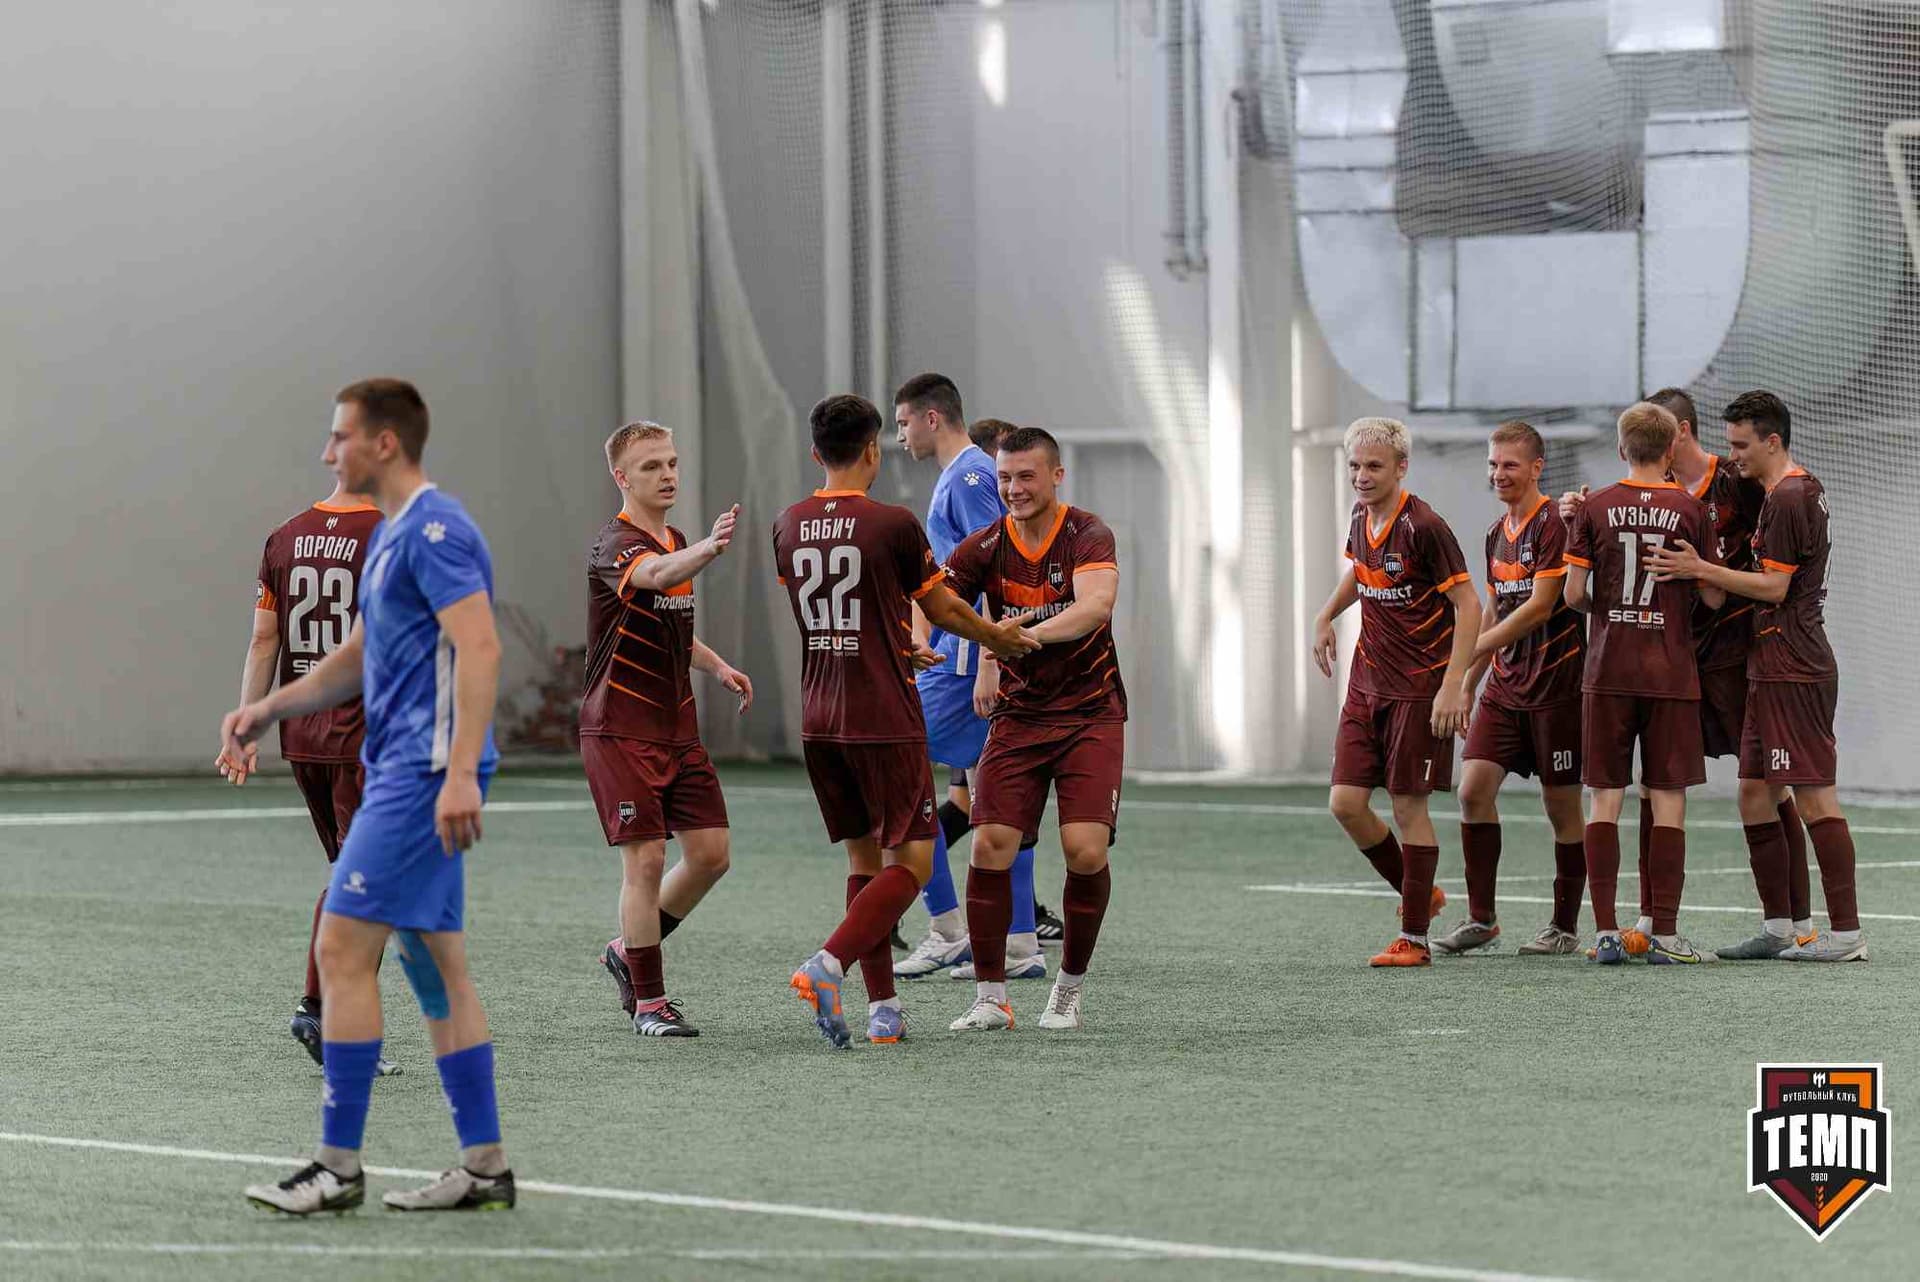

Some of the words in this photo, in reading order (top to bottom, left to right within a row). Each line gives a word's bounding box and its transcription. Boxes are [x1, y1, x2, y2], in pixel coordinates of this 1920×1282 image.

[799, 517, 857, 542] БАБИЧ
[1607, 506, 1681, 532] КУЗЬКИН
[294, 535, 358, 562] ВОРОНА
[1618, 531, 1666, 606] 17
[792, 545, 862, 631] 22
[288, 565, 354, 653] 23
[1608, 609, 1665, 624] SEUS
[808, 636, 859, 651] SEUS
[1424, 759, 1433, 781] 7
[1552, 750, 1573, 772] 20
[1771, 748, 1791, 770] 24
